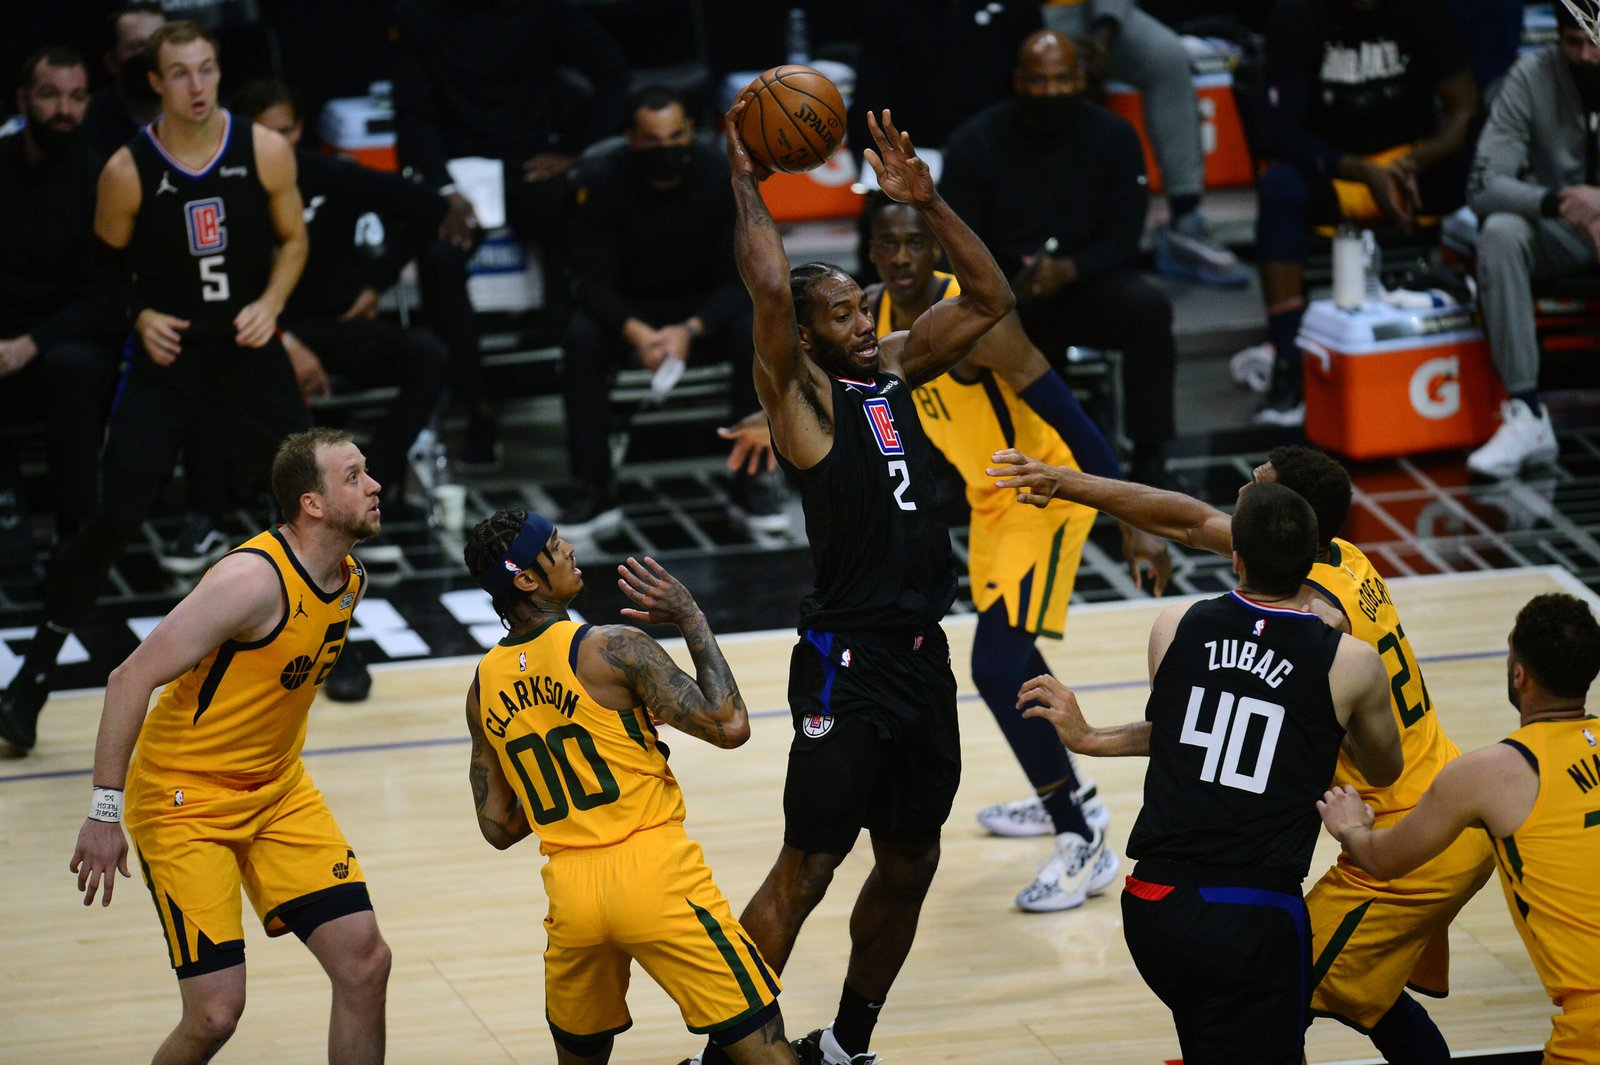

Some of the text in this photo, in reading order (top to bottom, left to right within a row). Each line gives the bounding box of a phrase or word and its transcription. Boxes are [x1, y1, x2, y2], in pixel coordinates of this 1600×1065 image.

[794, 101, 838, 150] SPALD
[199, 255, 230, 302] 5
[915, 386, 952, 422] 81
[1409, 356, 1461, 420] G
[888, 460, 917, 511] 2
[1204, 639, 1294, 689] ZUBAC
[486, 676, 580, 739] CLARKSON
[1179, 686, 1286, 795] 40
[505, 723, 621, 826] 00
